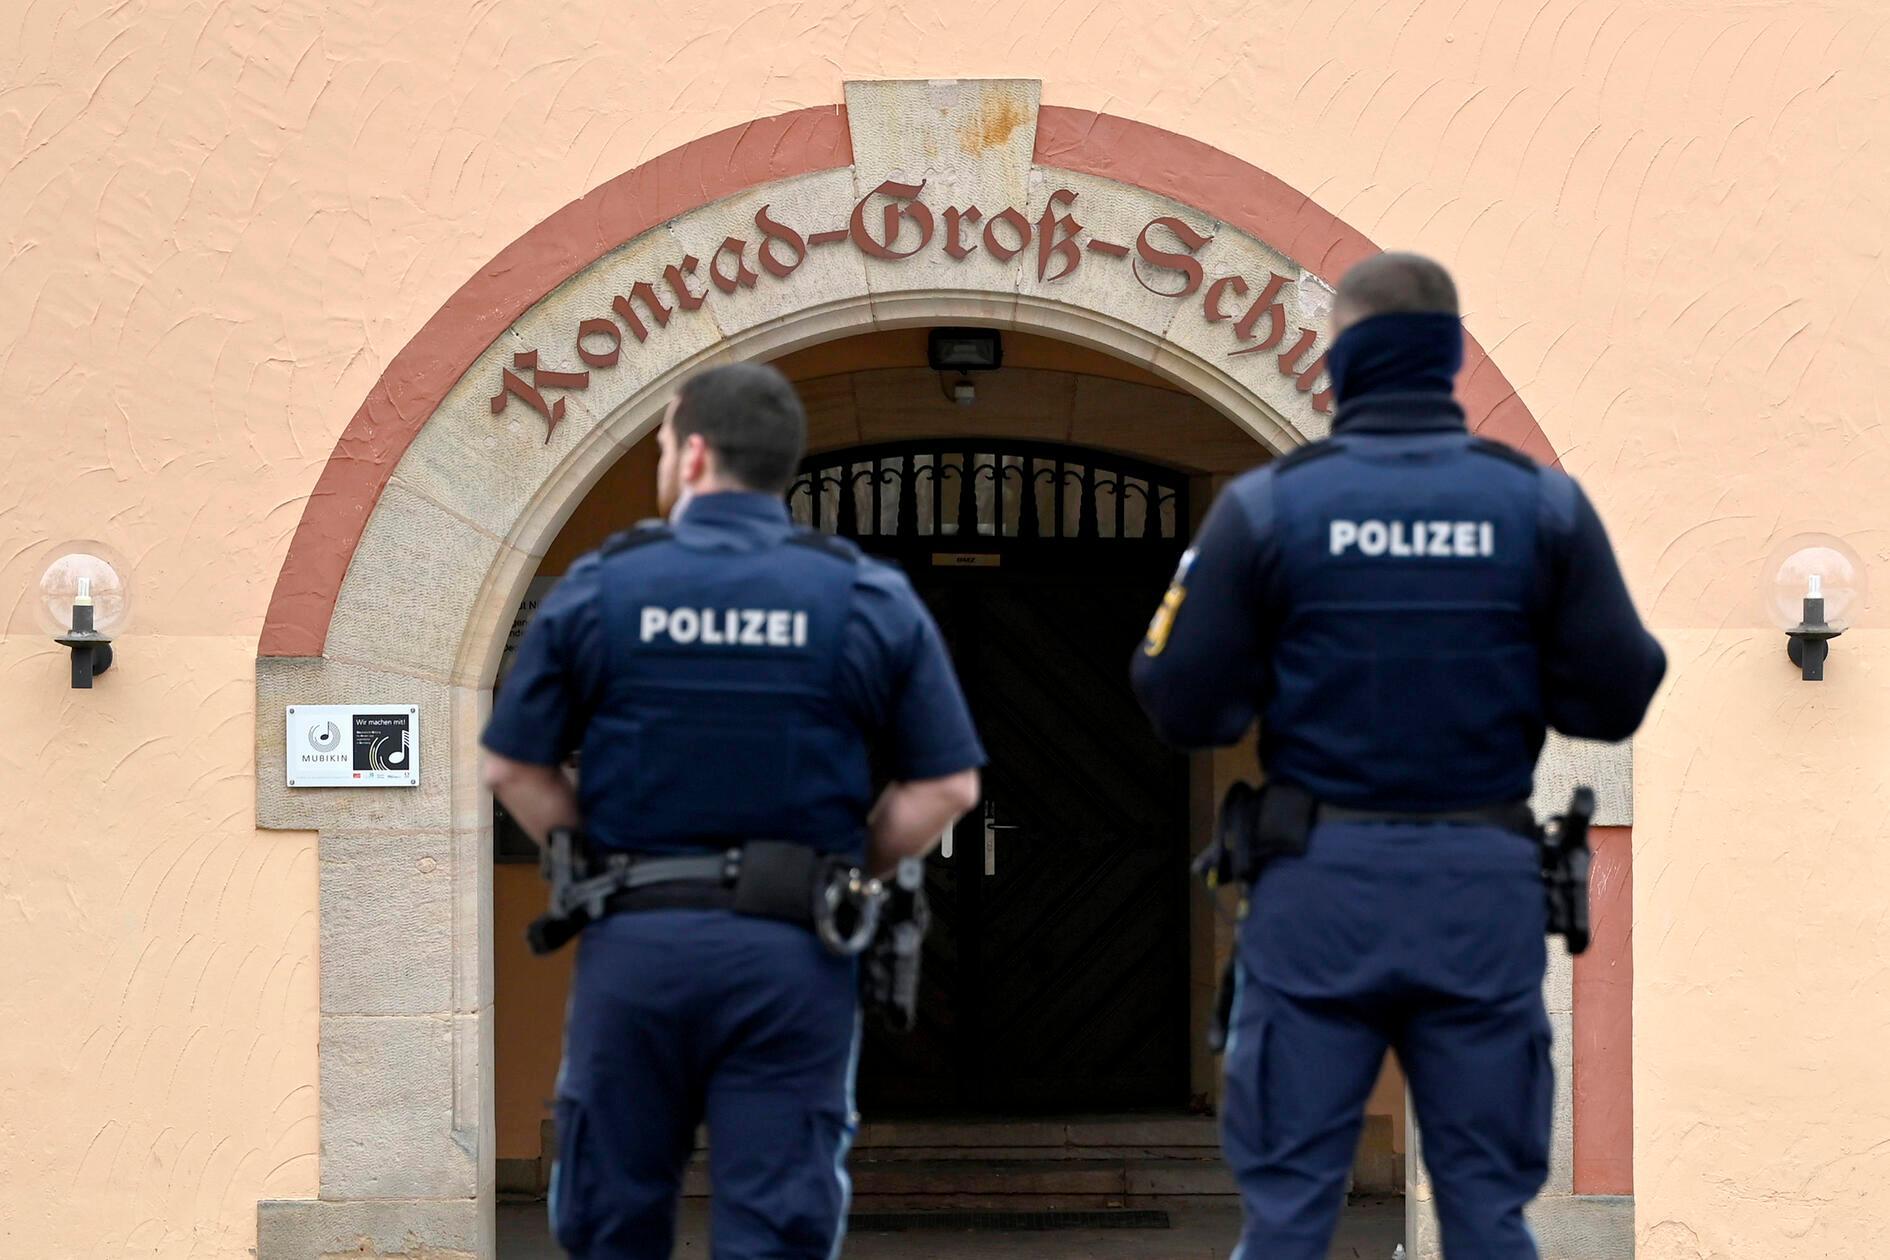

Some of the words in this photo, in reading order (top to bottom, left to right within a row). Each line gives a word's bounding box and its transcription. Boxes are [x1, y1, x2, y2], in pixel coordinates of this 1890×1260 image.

[1328, 519, 1495, 557] POLIZEI
[639, 606, 808, 647] POLIZEI
[301, 754, 348, 762] MUBIKIN
